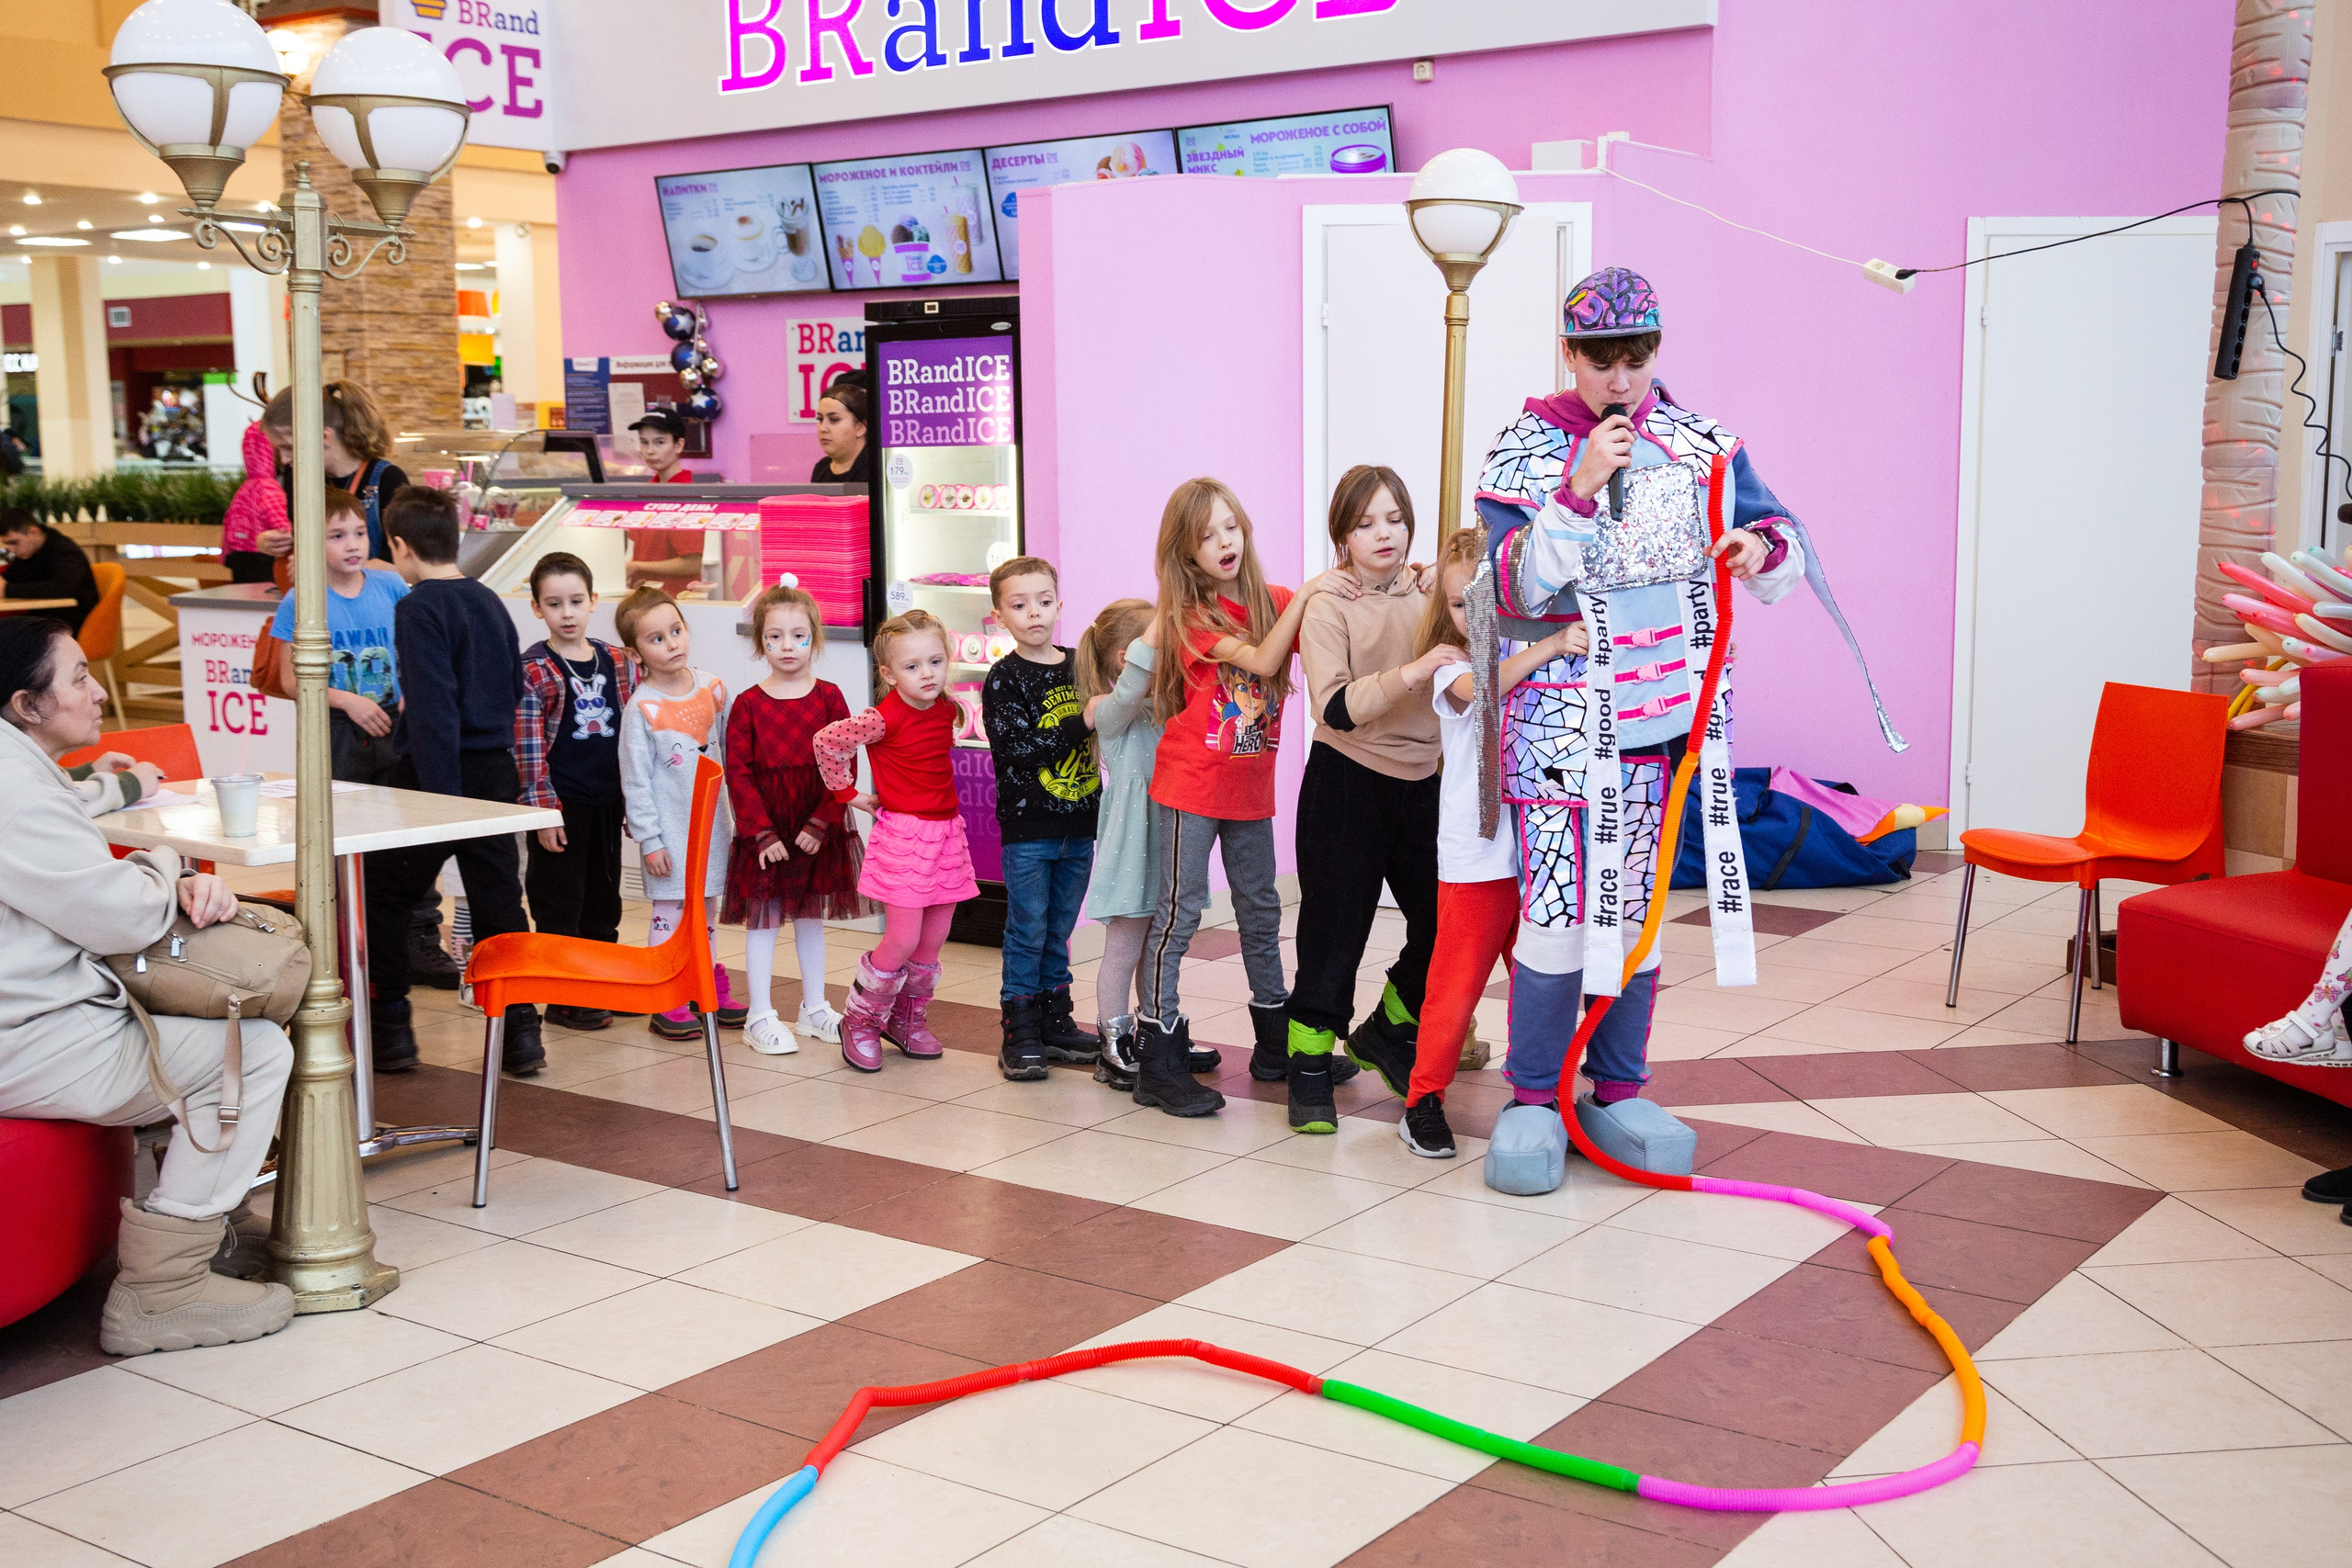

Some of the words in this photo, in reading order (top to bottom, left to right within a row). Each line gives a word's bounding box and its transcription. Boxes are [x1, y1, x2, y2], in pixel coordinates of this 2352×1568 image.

[458, 0, 540, 34] BRand
[720, 0, 1397, 92] BRan
[408, 30, 543, 118] CE
[1250, 125, 1330, 143] МОРОЖЕНОЕ
[1333, 125, 1340, 136] С
[1342, 117, 1387, 135] СОБОЙ
[992, 153, 1045, 171] ДЕСЕРТЫ
[1186, 146, 1245, 164] ЗВЕЗДНЫЙ
[819, 168, 888, 184] МОРОЖЕНОЕ
[889, 167, 898, 176] И
[899, 161, 958, 176] КОКТЕЙЛИ
[797, 322, 865, 354] BRan
[887, 355, 1011, 385] BRandICE
[888, 386, 1012, 415] BRandICE
[889, 416, 1012, 445] BRandICE
[890, 466, 905, 475] 179
[890, 591, 906, 601] 589
[1686, 580, 1717, 649] #party
[191, 632, 258, 649] МОРОЖЕН
[331, 626, 389, 649] AWAII
[1589, 595, 1613, 672] #party
[205, 659, 253, 684] BRan
[207, 690, 269, 736] ICE
[1594, 688, 1616, 761] #good
[1234, 732, 1262, 753] HERO
[1710, 767, 1730, 827] #true
[1594, 786, 1618, 844] #true
[1717, 851, 1743, 914] #race
[1593, 868, 1618, 928] #race
